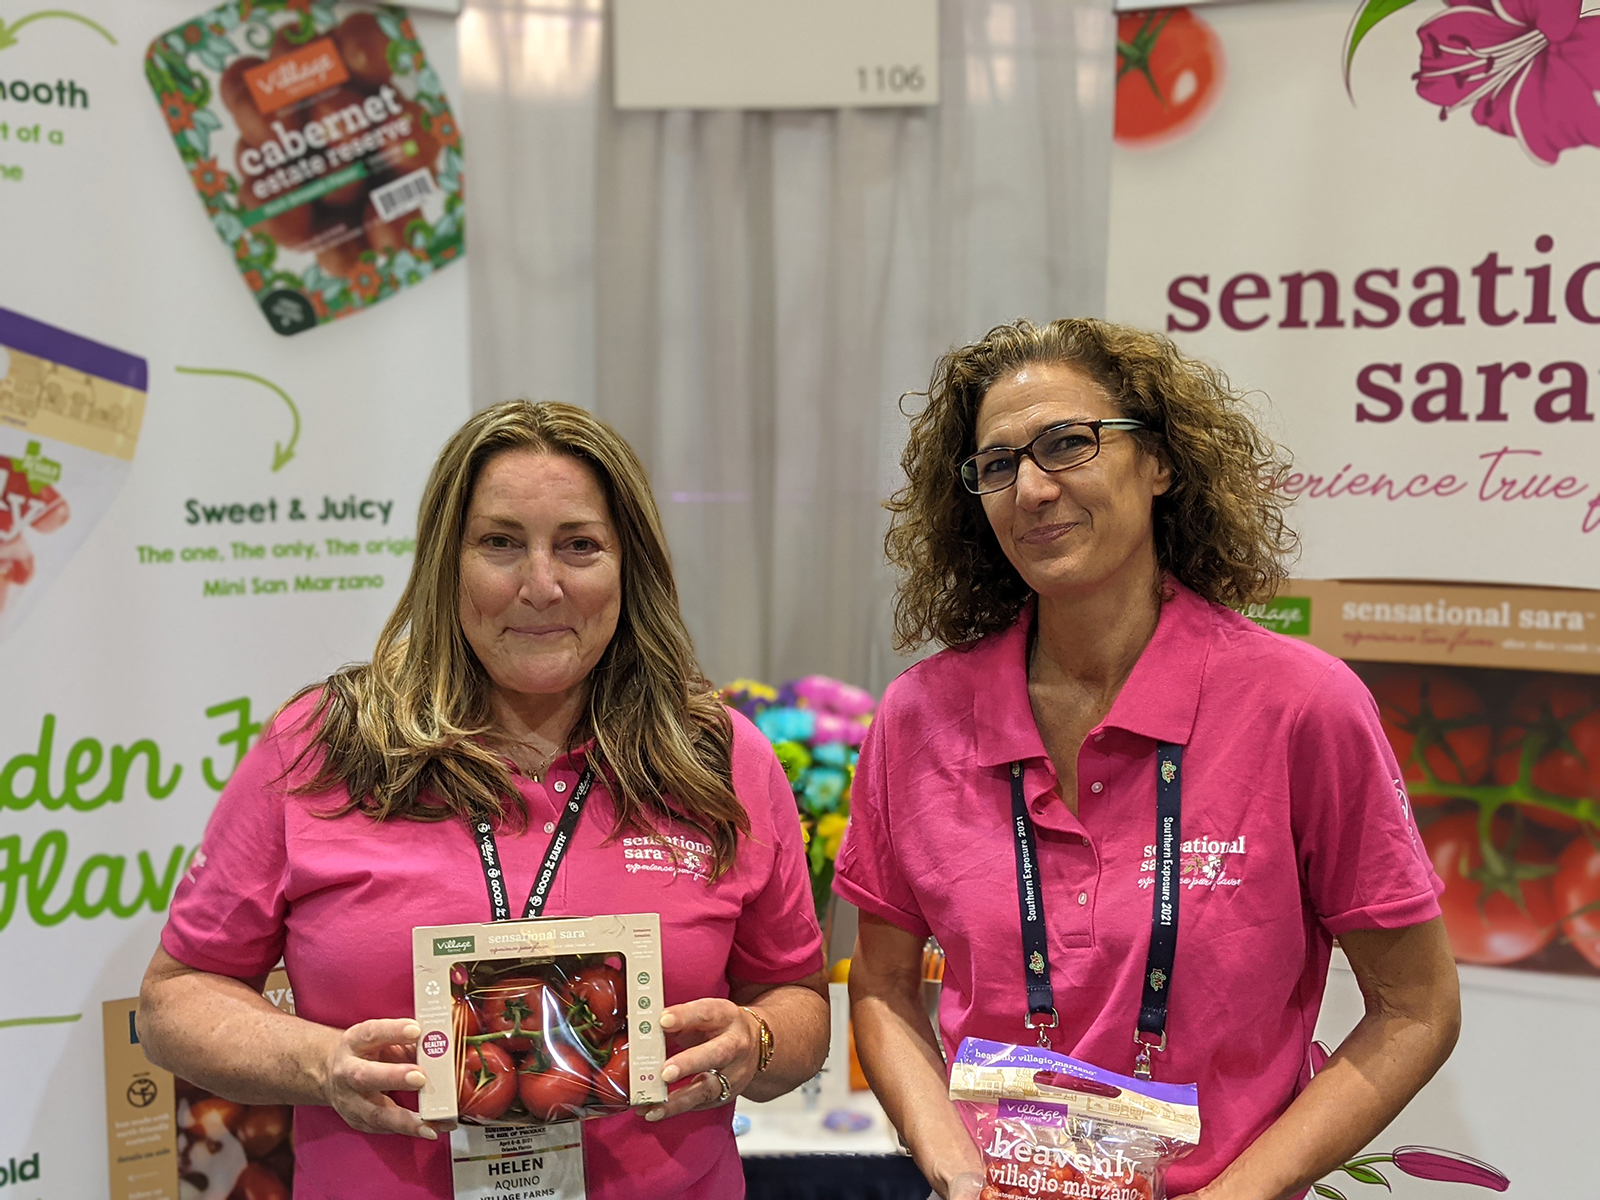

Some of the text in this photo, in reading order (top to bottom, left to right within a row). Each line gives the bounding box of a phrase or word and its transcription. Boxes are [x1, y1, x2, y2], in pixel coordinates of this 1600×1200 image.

[857, 64, 927, 94] 1106
[16, 124, 41, 144] of
[49, 130, 64, 147] a
[240, 85, 403, 176] cabernet
[252, 154, 327, 199] estate
[325, 117, 412, 168] reserve
[1355, 360, 1597, 425] sara
[185, 495, 394, 526] Sweet & Juicy
[136, 545, 174, 563] The
[230, 541, 266, 560] The
[325, 538, 361, 556] The
[203, 573, 385, 597] Mini San Marzano
[1341, 598, 1585, 631] sensational sara
[549, 831, 567, 863] EARTH
[623, 848, 663, 860] sara
[536, 870, 551, 895] GOOD
[1016, 815, 1038, 923] Southern Exposure 2021
[1159, 816, 1175, 926] Southern Exposure 2021
[491, 879, 504, 907] GOOD
[487, 929, 585, 945] sensational sara
[1018, 1053, 1053, 1066] villagio
[1053, 1060, 1098, 1076] marzano
[488, 1157, 543, 1176] HELEN
[986, 1127, 1142, 1185] heavenly
[495, 1175, 540, 1191] AQUINO
[523, 1187, 555, 1199] FARMS
[988, 1164, 1058, 1195] villagio
[1062, 1178, 1139, 1200] marzano
